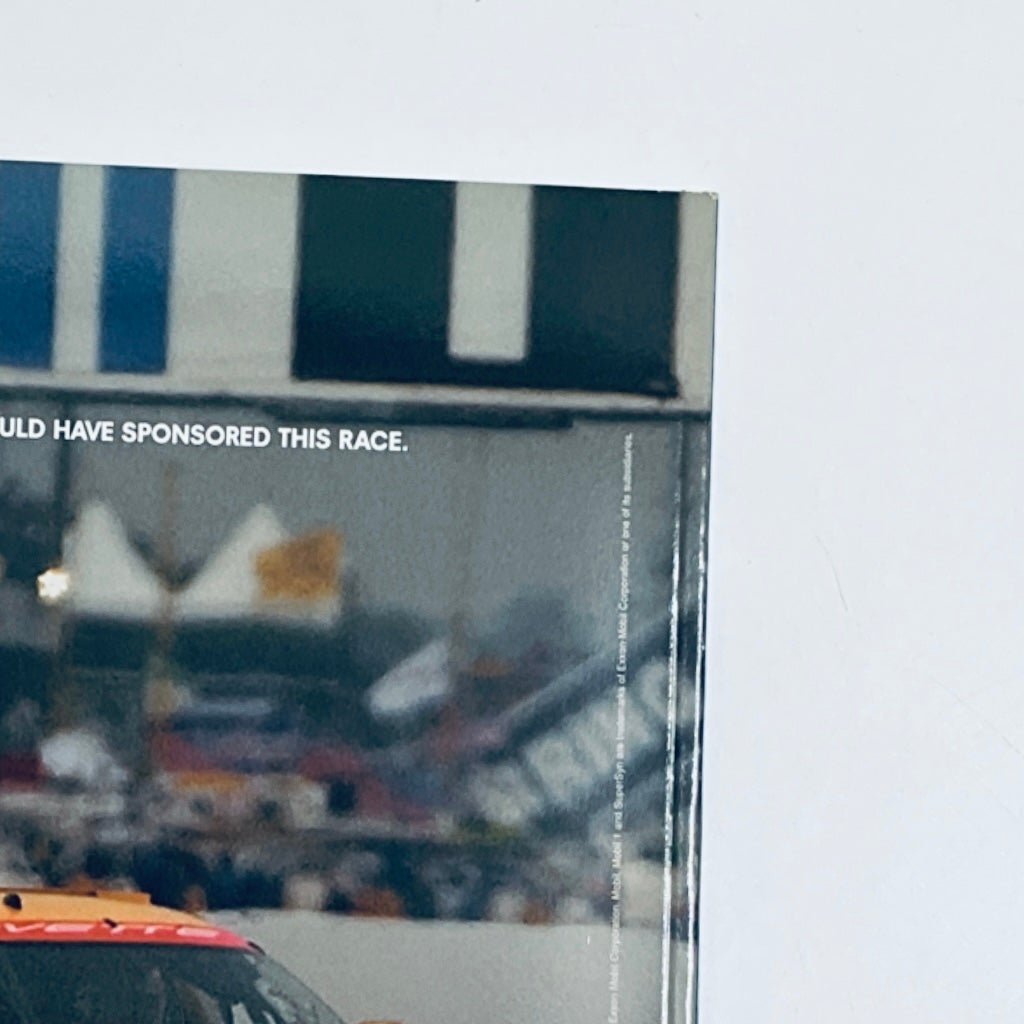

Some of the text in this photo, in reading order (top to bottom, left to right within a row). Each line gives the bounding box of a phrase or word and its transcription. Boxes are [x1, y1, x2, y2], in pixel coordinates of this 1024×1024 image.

[53, 419, 115, 442] HAVE
[121, 421, 271, 448] SPONSORED
[277, 427, 332, 450] THIS
[338, 429, 409, 452] RACE.
